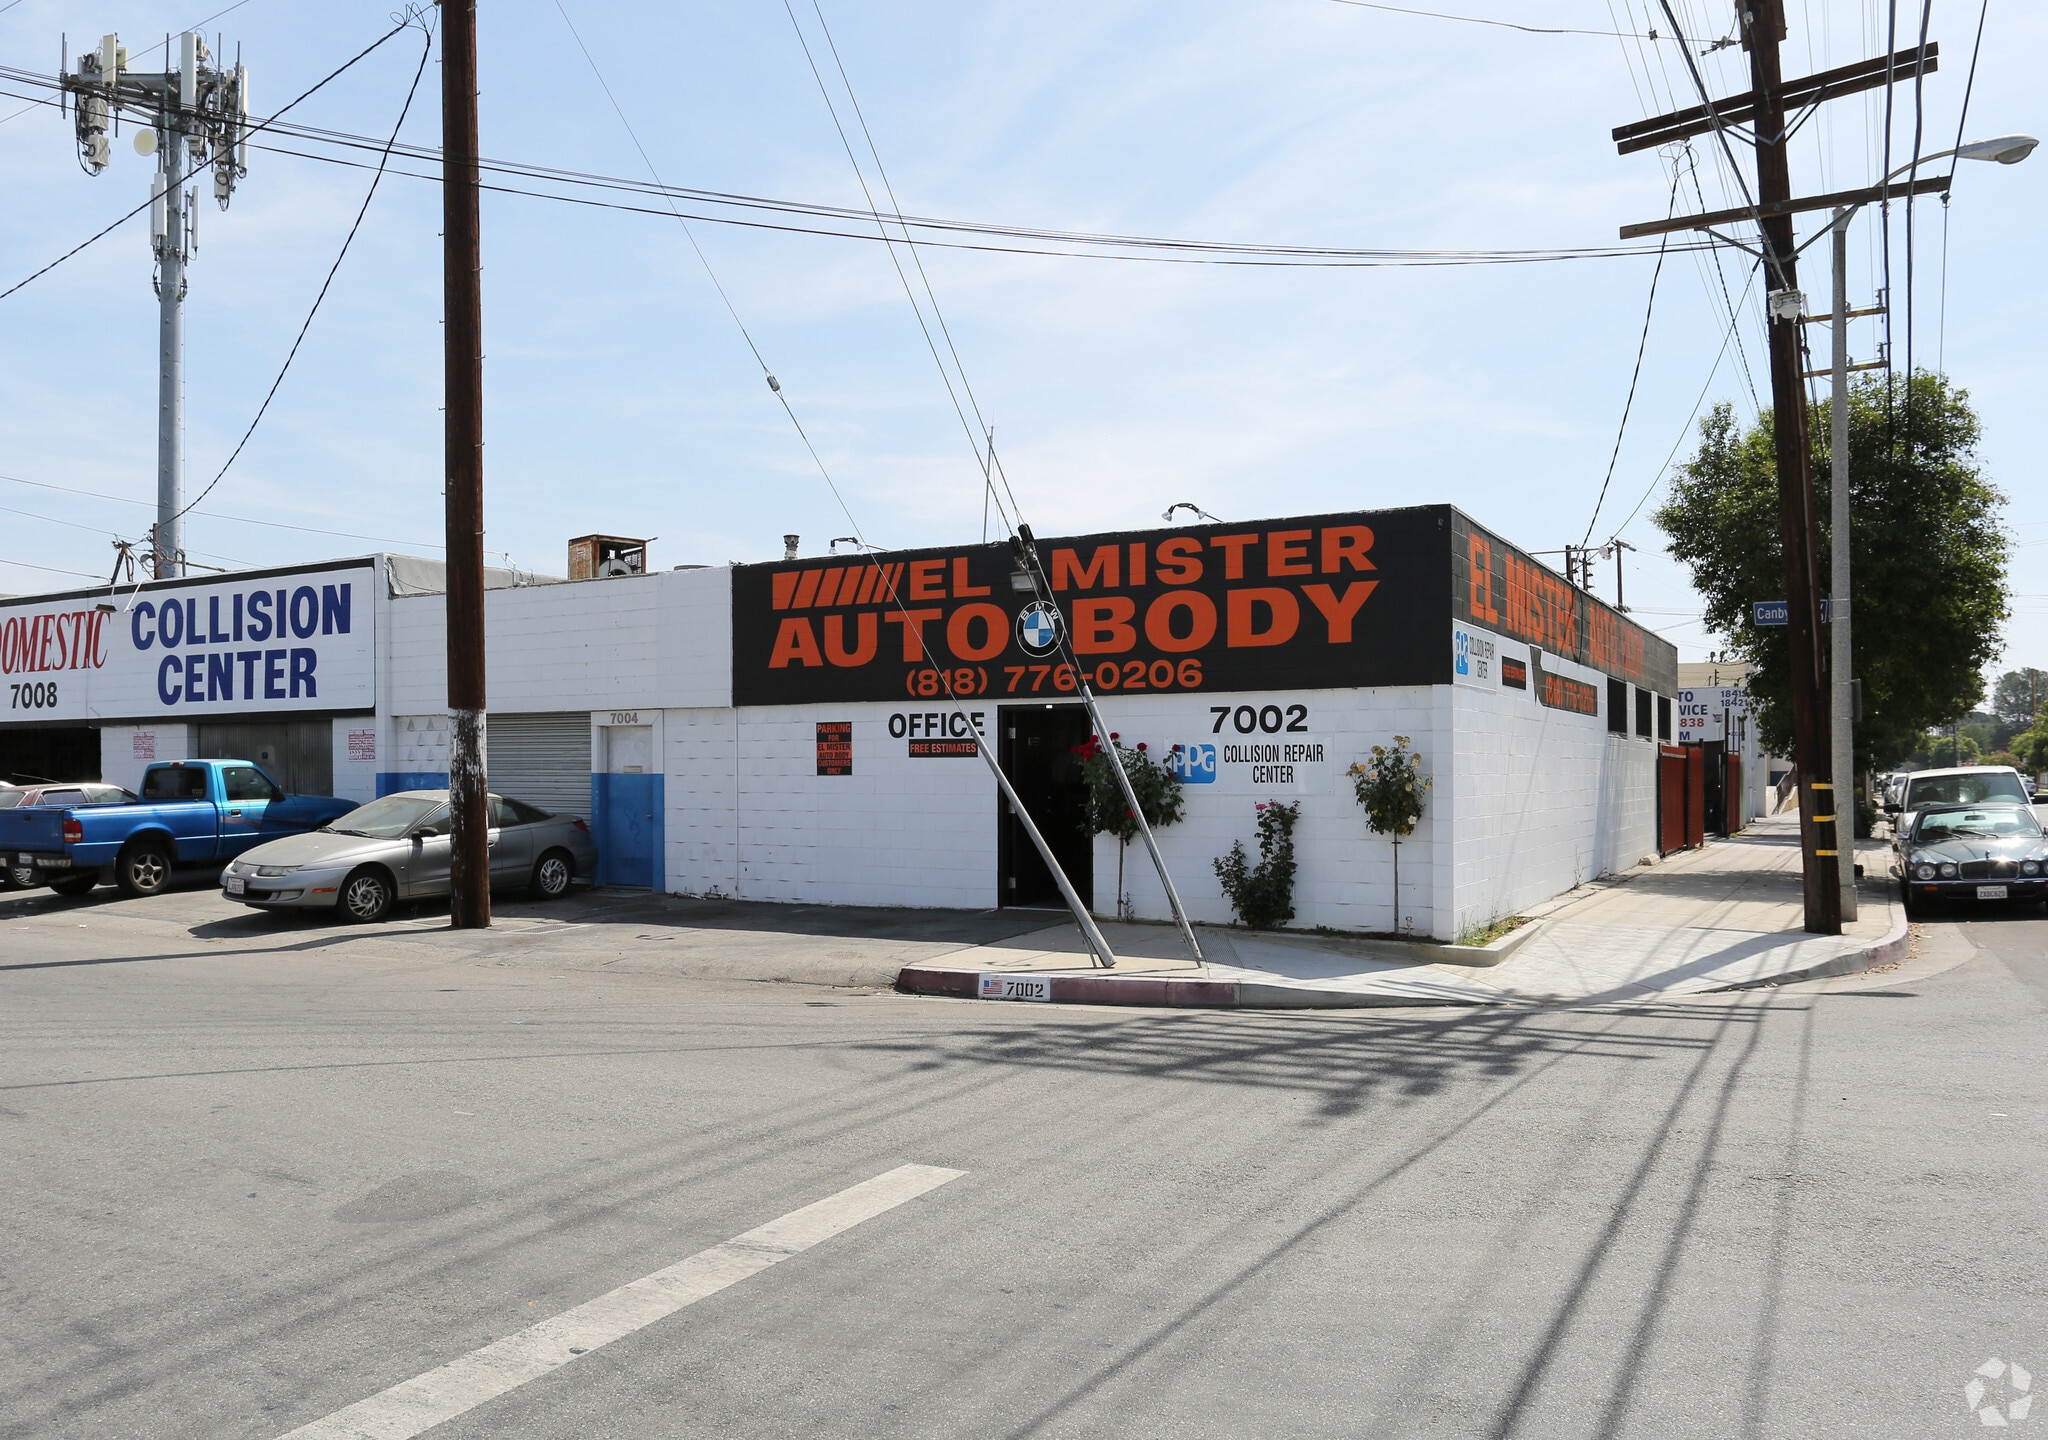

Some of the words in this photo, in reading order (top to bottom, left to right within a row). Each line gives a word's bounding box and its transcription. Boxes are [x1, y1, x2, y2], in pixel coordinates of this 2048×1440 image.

[910, 557, 991, 600] EL
[1052, 525, 1378, 592] MISTER
[1469, 532, 1498, 625] EL
[1505, 553, 1577, 655] MISTER
[131, 583, 352, 651] COLLISION
[1020, 602, 1059, 621] BMW
[768, 602, 1010, 669] AUTO
[1072, 579, 1380, 655] BODY
[0, 610, 111, 674] OMESTIC
[157, 647, 318, 705] CENTER
[905, 663, 988, 697] (818)
[1003, 658, 1203, 694] 776-0206
[10, 681, 58, 709] 7008
[610, 712, 639, 724] 7004
[888, 711, 985, 739] OFFICE
[1210, 704, 1308, 734] 7002
[1680, 718, 1704, 728] 838
[817, 723, 851, 733] PARKING
[818, 743, 825, 751] EL
[827, 743, 851, 751] MISTER
[828, 734, 840, 742] FOR
[819, 751, 833, 759] AUTO
[835, 751, 849, 759] BODY
[909, 744, 930, 753] FREE
[931, 743, 977, 753] ESTIMATES
[1223, 744, 1280, 763] COLLISION
[1284, 744, 1324, 763] REPAIR
[1252, 765, 1294, 784] CENTER
[1006, 982, 1044, 998] 7002
